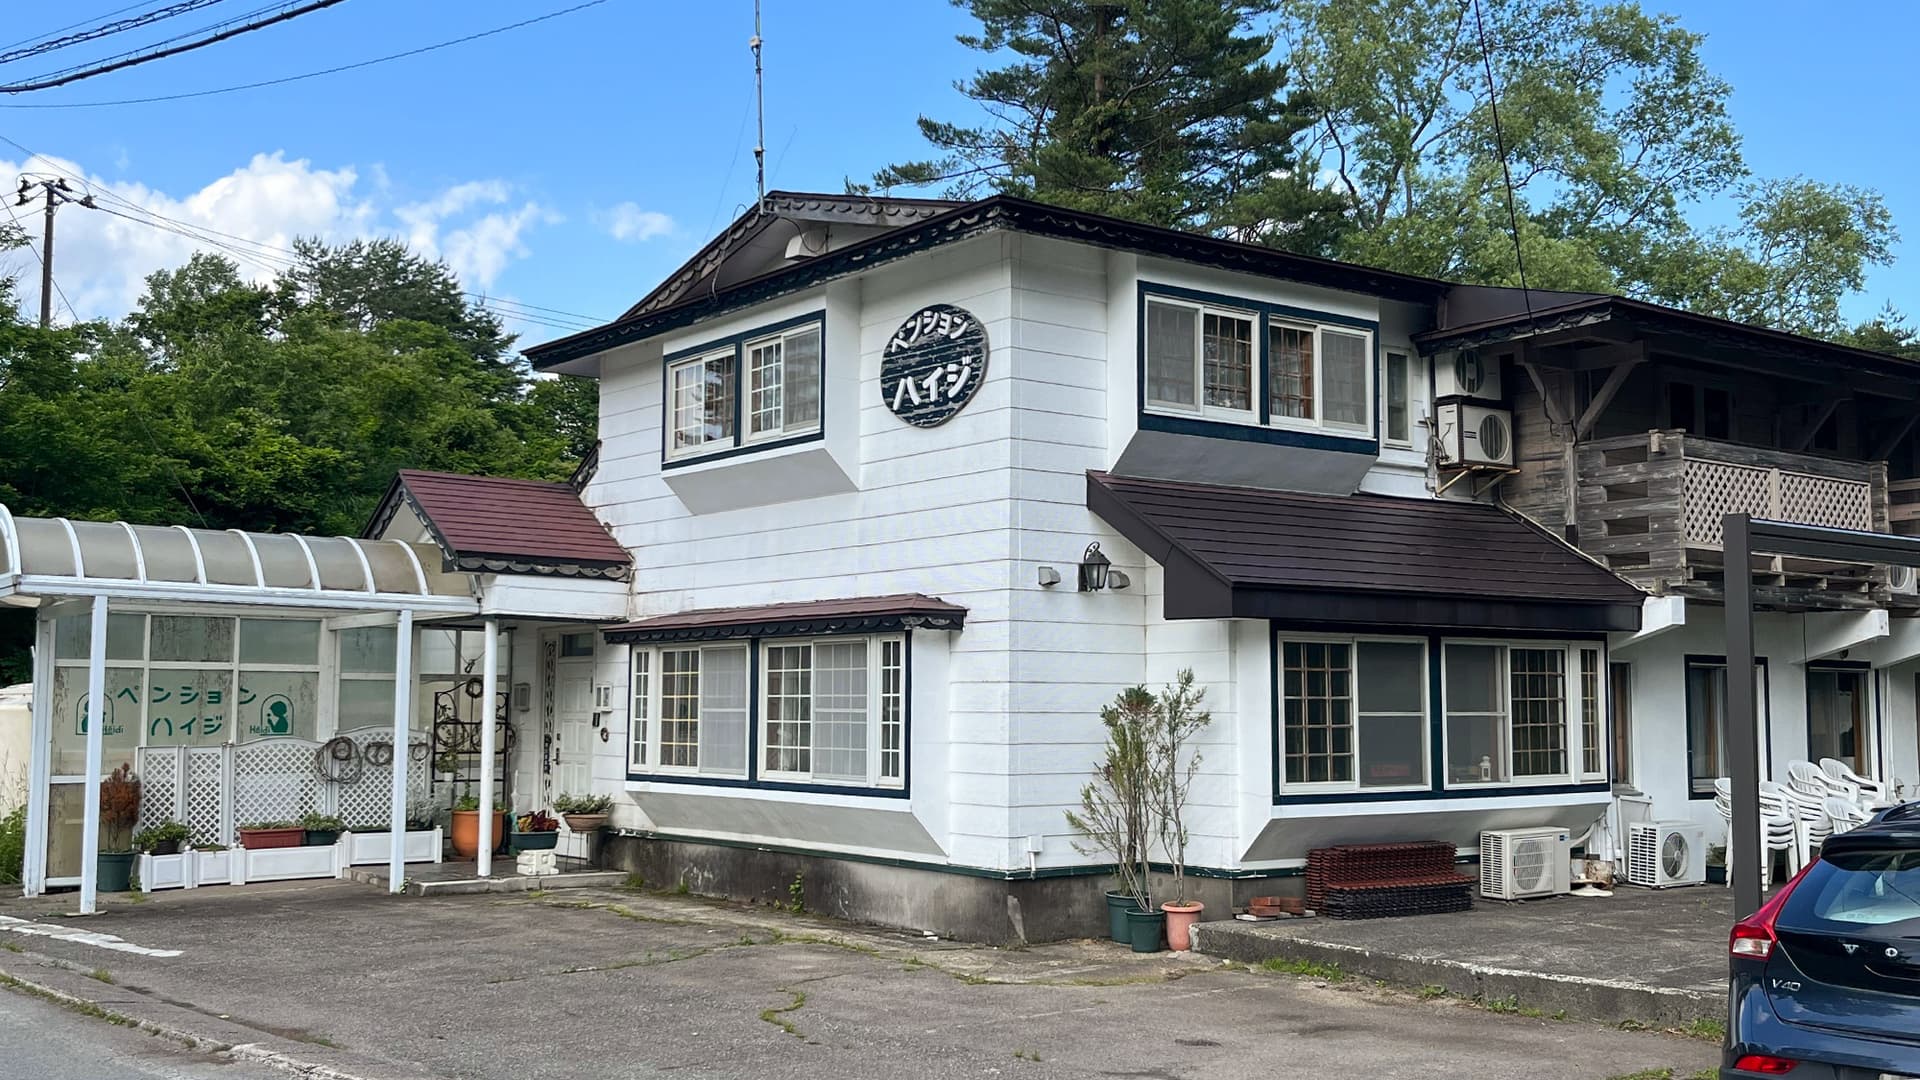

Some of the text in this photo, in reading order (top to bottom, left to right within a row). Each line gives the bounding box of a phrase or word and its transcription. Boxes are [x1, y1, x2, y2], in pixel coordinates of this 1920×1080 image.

[892, 311, 968, 352] ペンション
[893, 356, 972, 411] ハイジ
[118, 686, 256, 704] ペンション
[151, 716, 223, 736] ハイジ
[1772, 978, 1800, 991] V40
